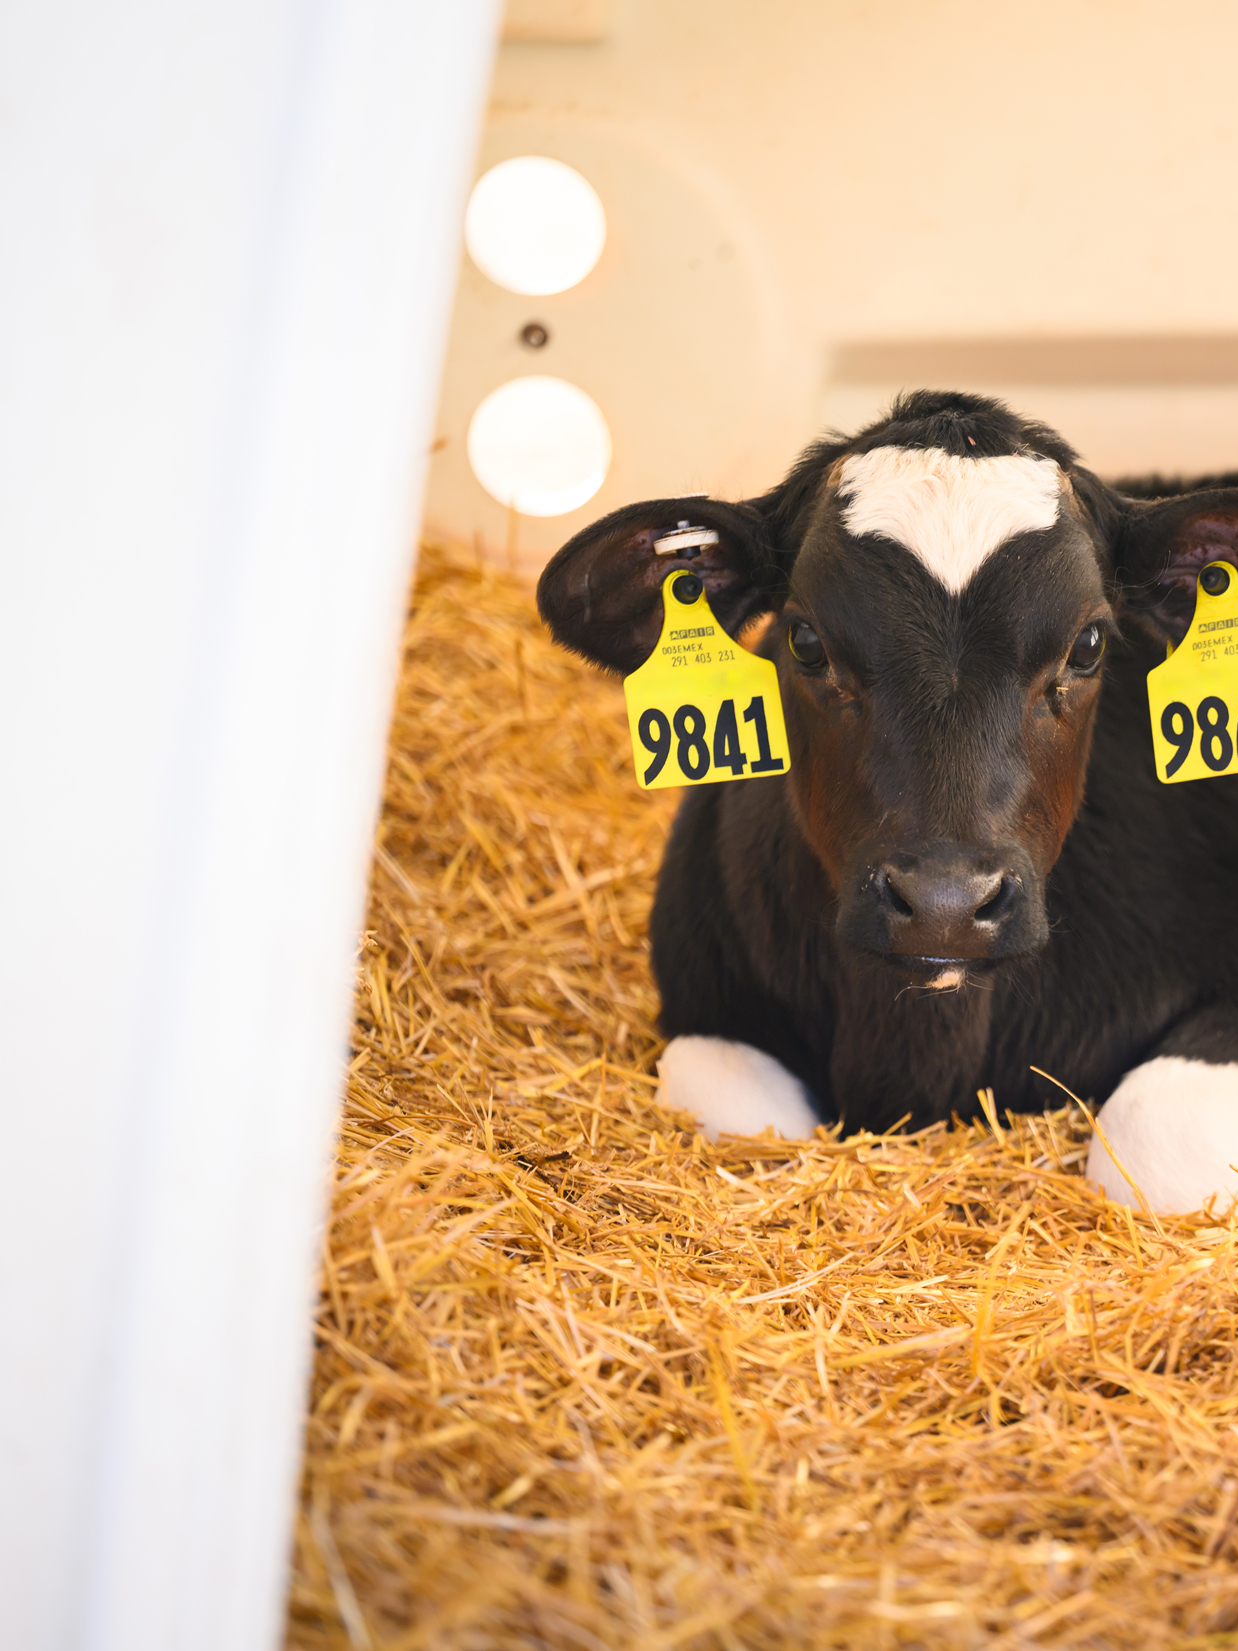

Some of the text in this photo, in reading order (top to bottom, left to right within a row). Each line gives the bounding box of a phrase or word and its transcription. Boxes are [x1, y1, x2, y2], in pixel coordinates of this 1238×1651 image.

[671, 650, 736, 667] 291 403 231
[1201, 649, 1217, 662] 291
[638, 696, 784, 786] 9841
